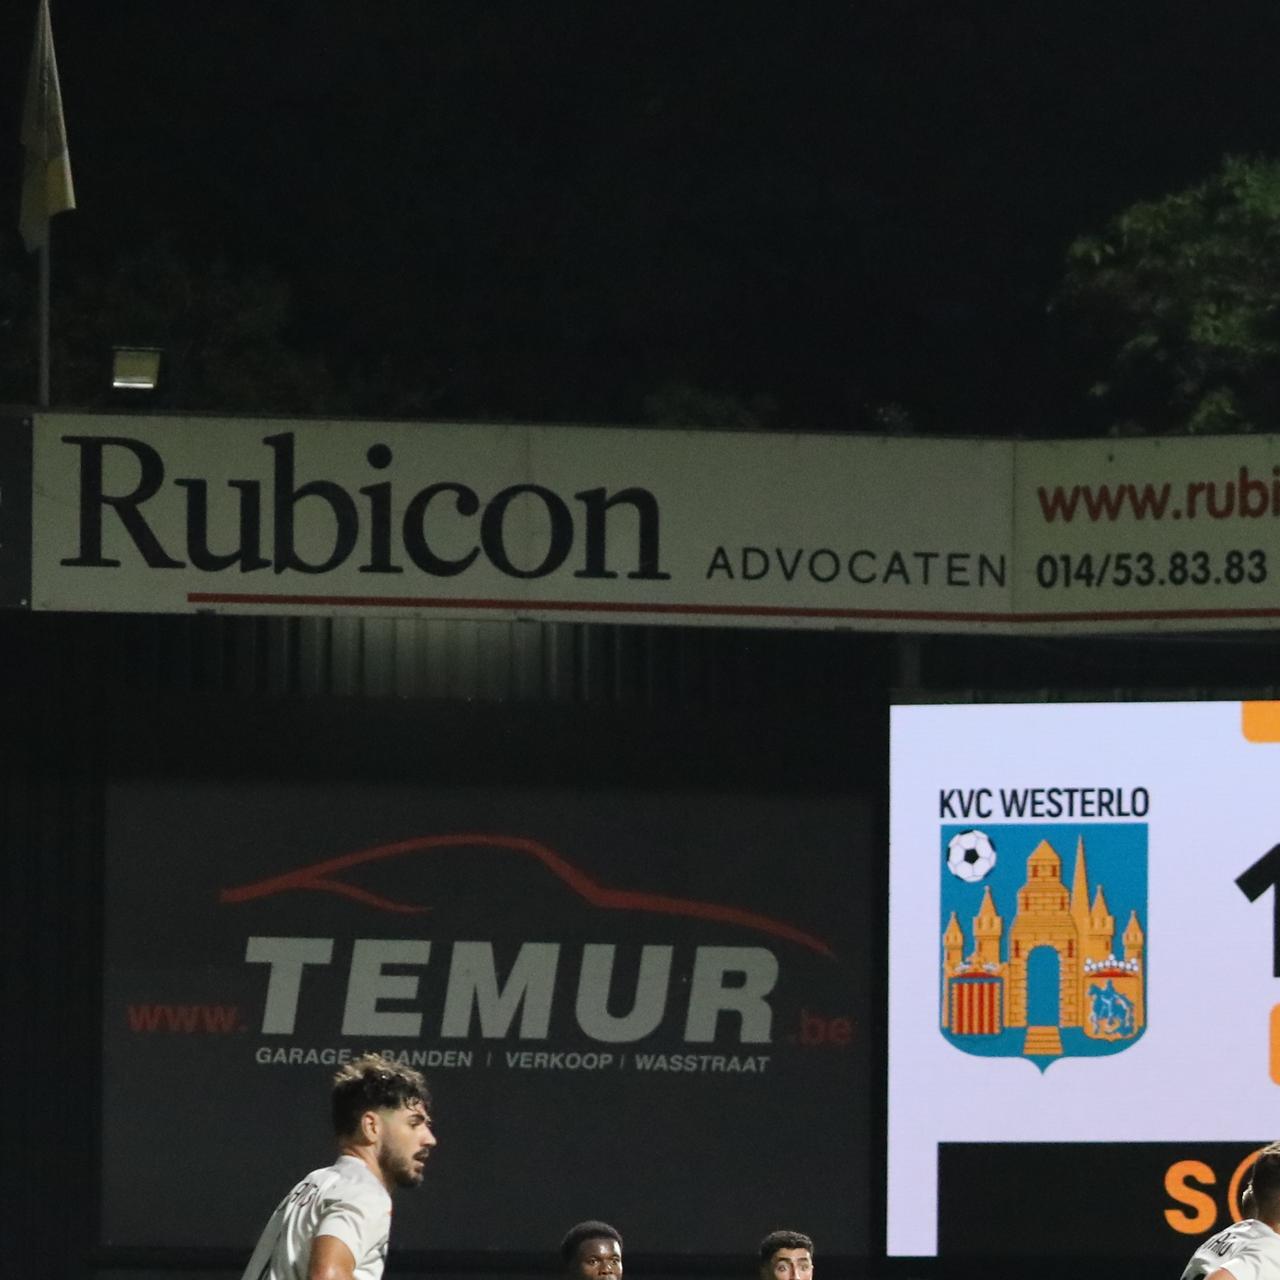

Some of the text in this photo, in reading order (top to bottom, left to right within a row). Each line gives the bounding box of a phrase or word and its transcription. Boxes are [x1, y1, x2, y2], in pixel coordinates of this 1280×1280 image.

[59, 431, 1006, 588] Rubicon ADVOCATEN
[1035, 550, 1269, 590] 014/53.83.83
[939, 786, 1150, 820] KVC WESTERLO
[245, 936, 781, 1044] TEMUR
[255, 1047, 771, 1074] GARAGE BANDEN VERKOOP WASSTRAAT
